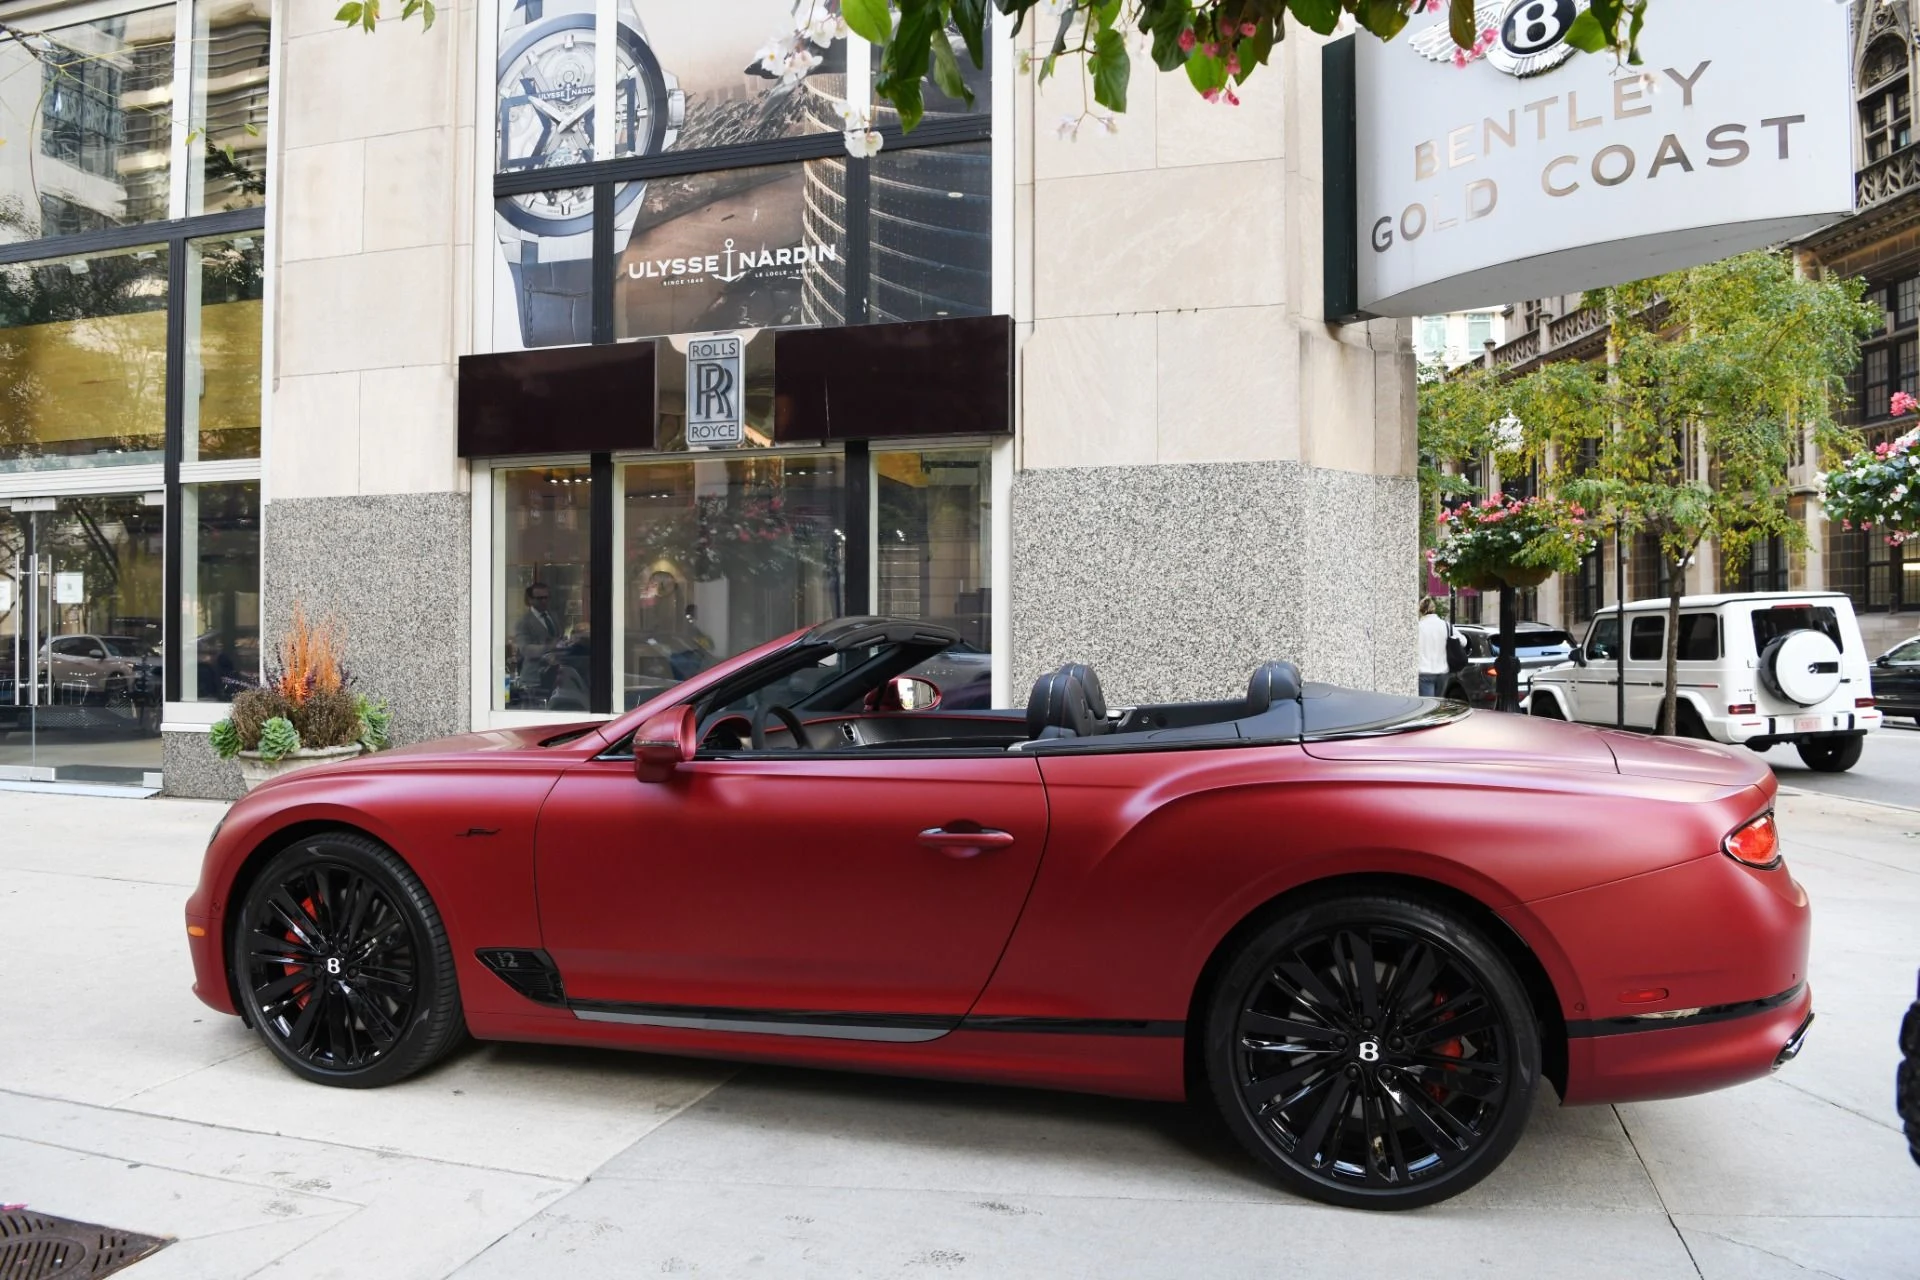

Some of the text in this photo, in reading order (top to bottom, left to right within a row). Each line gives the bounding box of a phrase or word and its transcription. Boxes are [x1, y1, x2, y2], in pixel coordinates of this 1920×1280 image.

[1512, 0, 1561, 49] B
[571, 87, 595, 95] NARD
[1414, 60, 1713, 182] BENTLEY
[1371, 114, 1806, 253] GOLD COAST
[628, 244, 836, 279] ULYSSE NARDIN
[692, 342, 736, 358] ROLLS
[691, 424, 736, 438] ROYCE
[1358, 1041, 1380, 1062] B
